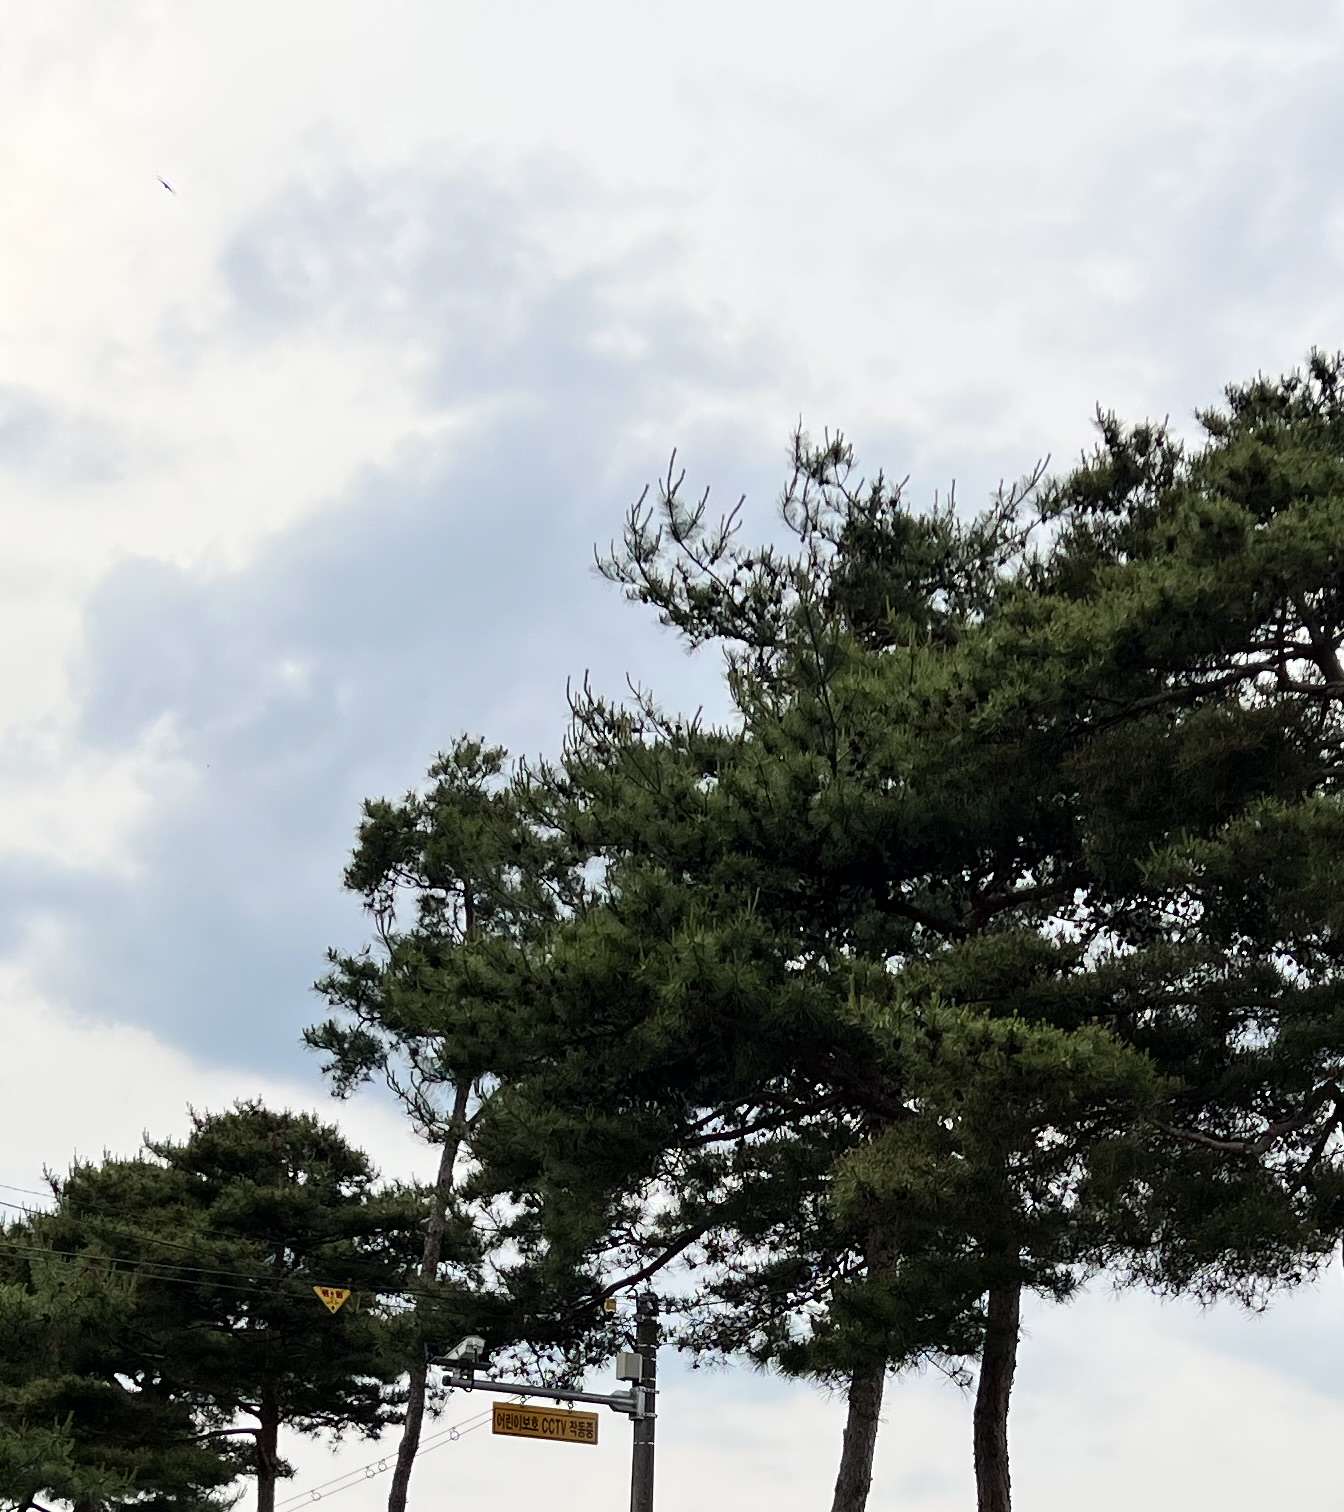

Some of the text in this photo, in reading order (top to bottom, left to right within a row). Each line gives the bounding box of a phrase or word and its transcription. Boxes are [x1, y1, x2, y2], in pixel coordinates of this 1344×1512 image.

[496, 1412, 594, 1439] 어린이보호 CCTV 작동중
